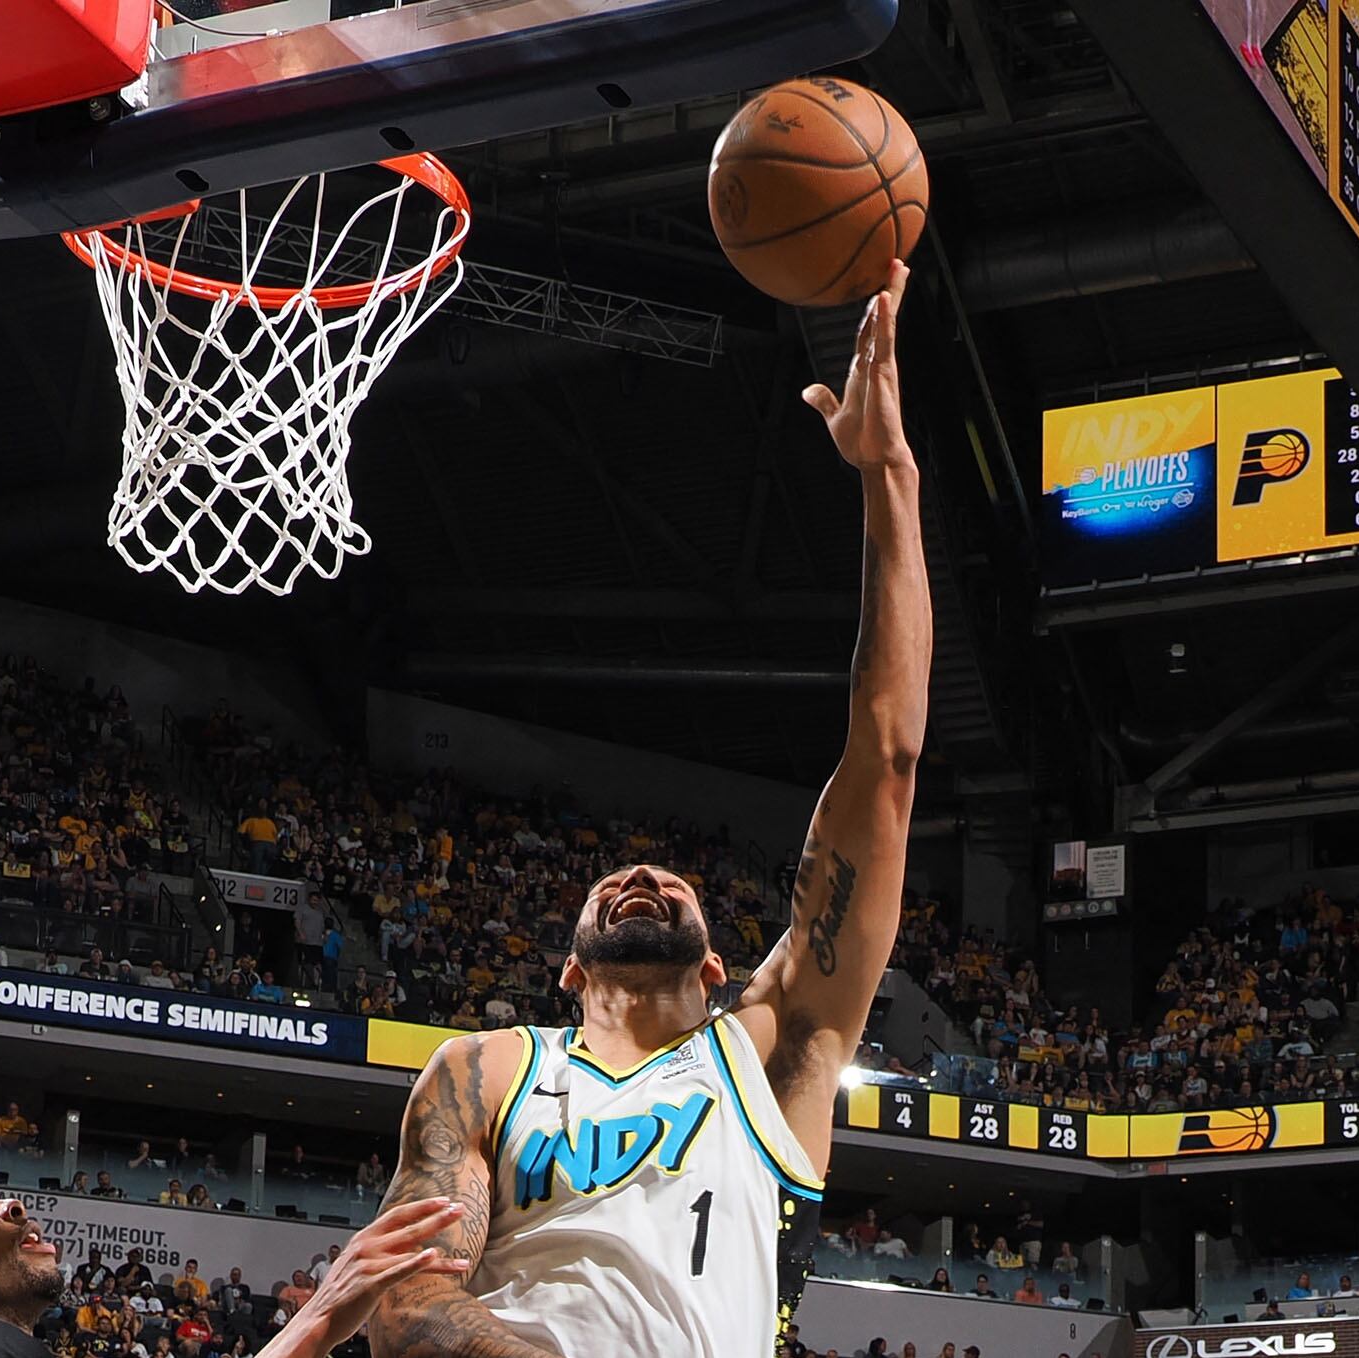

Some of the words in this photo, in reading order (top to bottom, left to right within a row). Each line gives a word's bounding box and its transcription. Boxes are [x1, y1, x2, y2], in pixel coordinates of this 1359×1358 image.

[1101, 451, 1189, 492] PLAYOFFS
[1337, 448, 1358, 464] 28
[272, 887, 298, 906] 213
[167, 1002, 328, 1046] SEMIFINALS
[895, 1093, 914, 1106] STL
[974, 1103, 995, 1116] AST
[1052, 1112, 1073, 1125] REB
[896, 1106, 912, 1129] 4
[969, 1115, 1000, 1141] 28
[1048, 1125, 1077, 1151] 28
[1343, 1115, 1358, 1138] 5
[514, 1091, 716, 1211] INDY
[689, 1189, 714, 1280] 1
[1196, 1332, 1336, 1358] LEXUS
